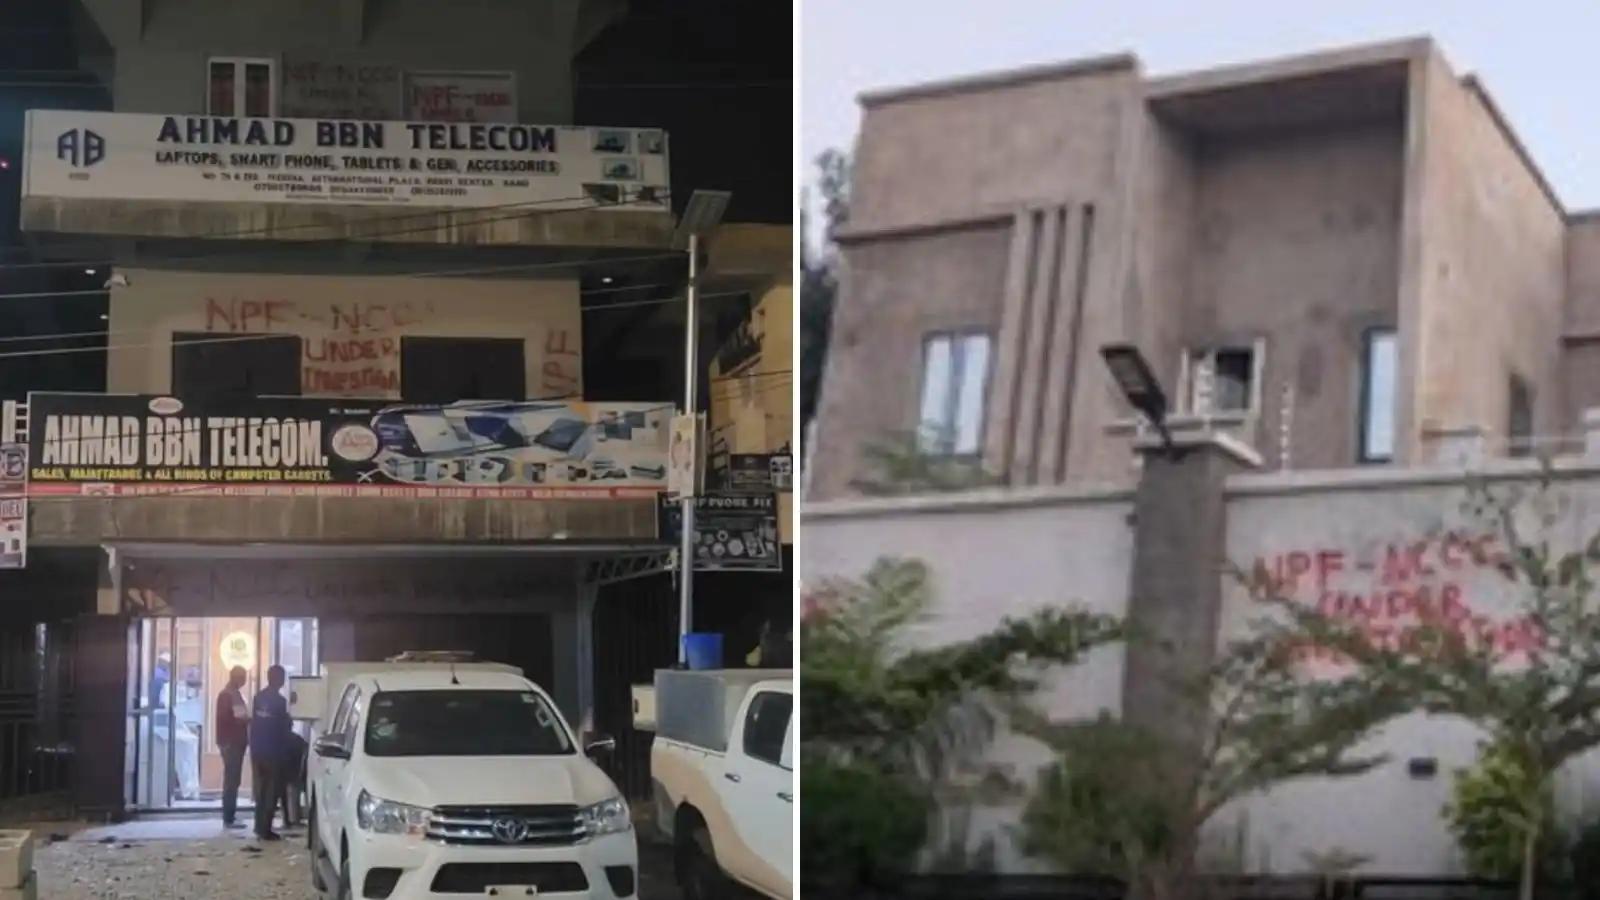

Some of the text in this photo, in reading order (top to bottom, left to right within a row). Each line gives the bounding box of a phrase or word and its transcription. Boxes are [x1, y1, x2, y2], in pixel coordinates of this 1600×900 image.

[156, 117, 556, 152] AHMAD BBN TELECOM
[156, 151, 223, 168] LAPTOPS,
[231, 153, 276, 168] SMART
[342, 156, 400, 170] TABLETS
[409, 157, 420, 170] &
[43, 414, 139, 465] AHMAD
[147, 416, 200, 467] BBN
[207, 417, 329, 467] TELECOM.
[155, 470, 172, 480] ALL
